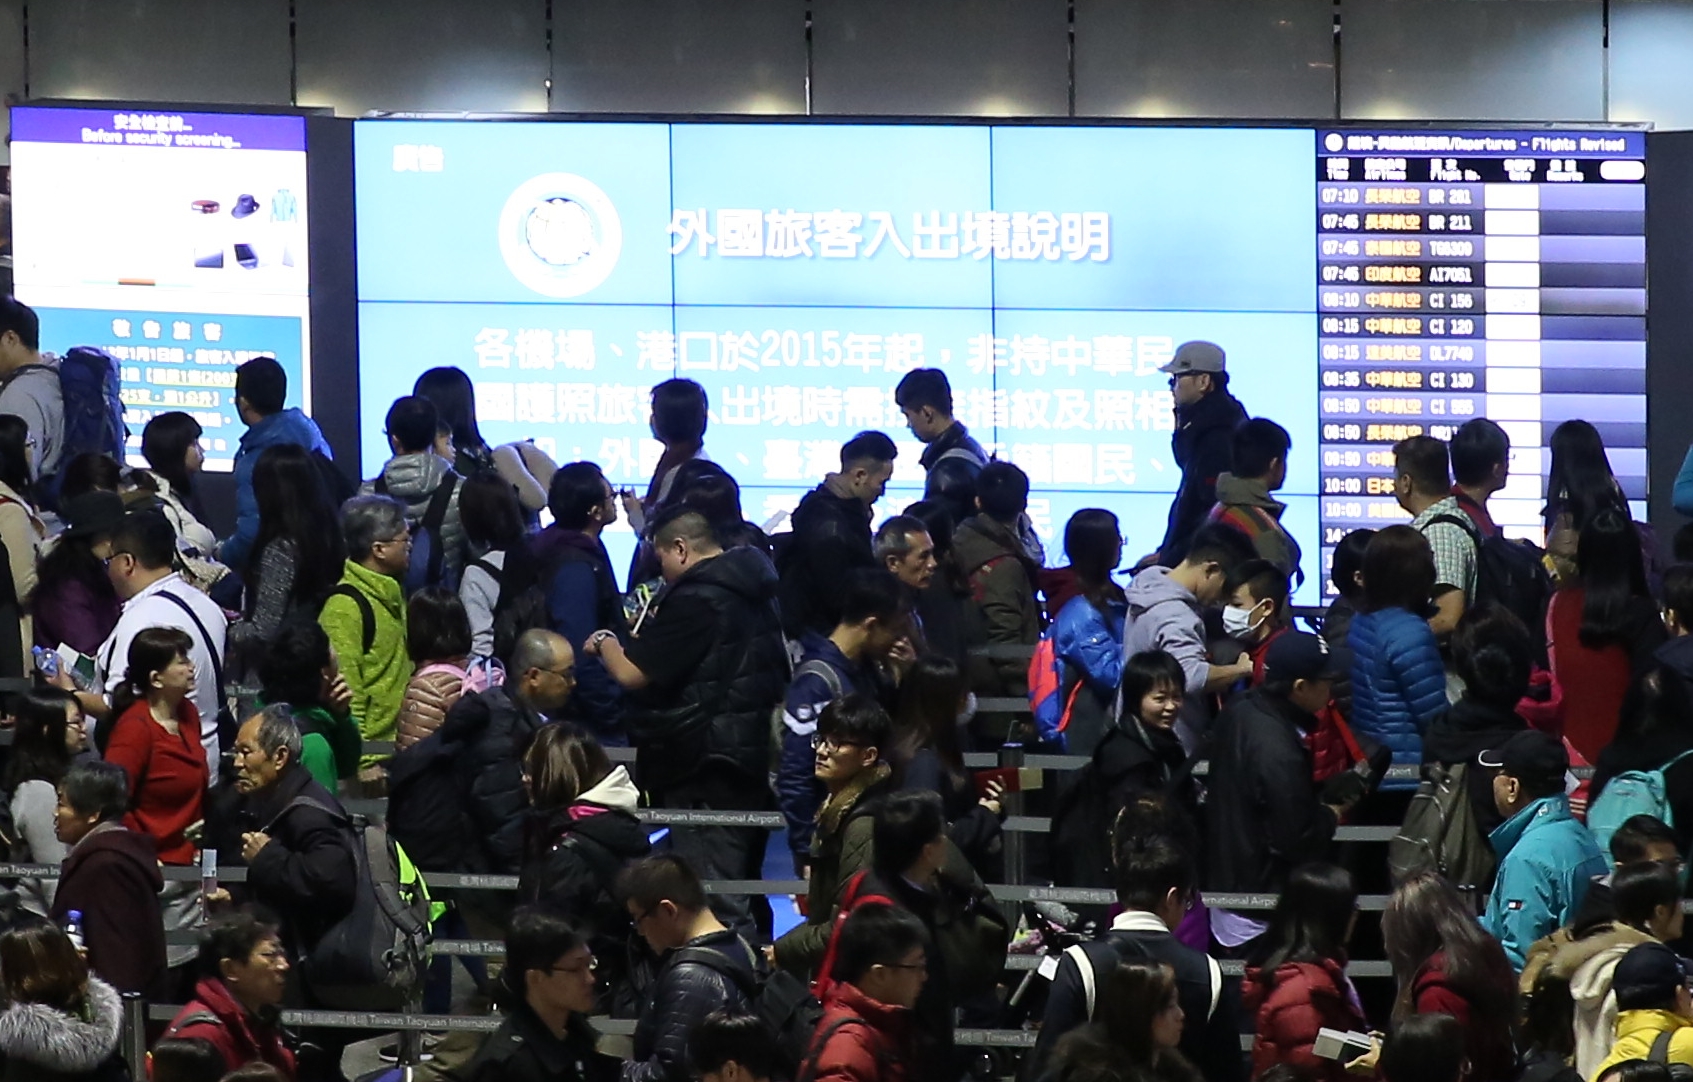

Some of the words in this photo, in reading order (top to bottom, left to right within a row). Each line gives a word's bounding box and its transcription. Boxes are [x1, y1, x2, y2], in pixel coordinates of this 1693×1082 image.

[82, 127, 122, 142] Before
[667, 207, 1111, 262] 外國旅客入出境說明
[1430, 292, 1445, 308] CI
[1430, 318, 1445, 335] CI
[1430, 371, 1445, 389] CI
[1431, 398, 1446, 415] CI
[1325, 477, 1361, 493] 10:00
[1367, 477, 1395, 493] 日本
[748, 812, 780, 825] Airport
[405, 1016, 447, 1030] Taoyuan
